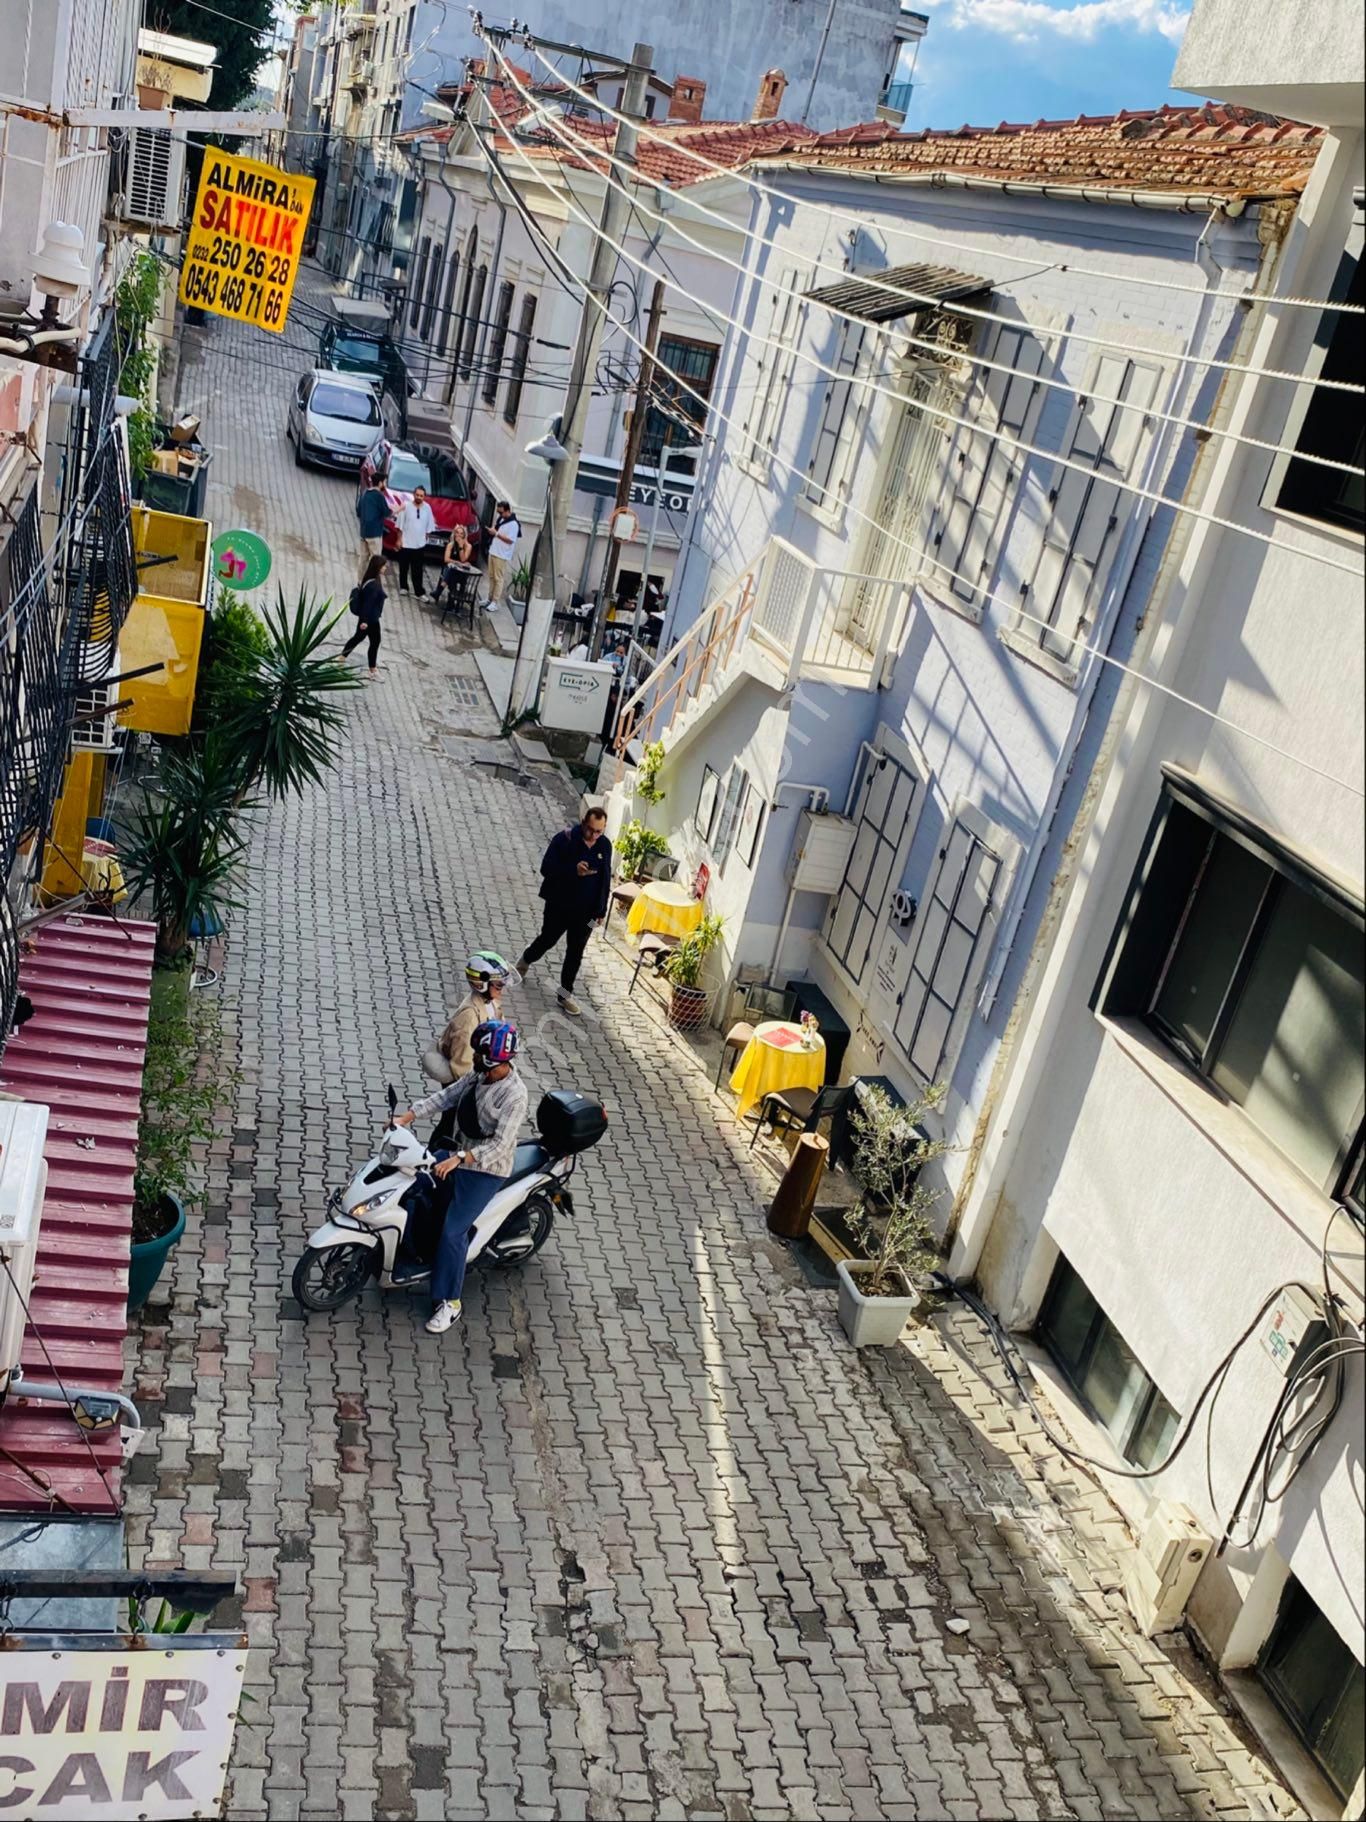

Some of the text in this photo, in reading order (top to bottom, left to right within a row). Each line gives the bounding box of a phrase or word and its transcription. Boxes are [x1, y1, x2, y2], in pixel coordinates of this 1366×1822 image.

[200, 190, 298, 256] SATILIK
[192, 236, 290, 286] 0232 250 26 28
[185, 264, 284, 326] 0543 468 71 66
